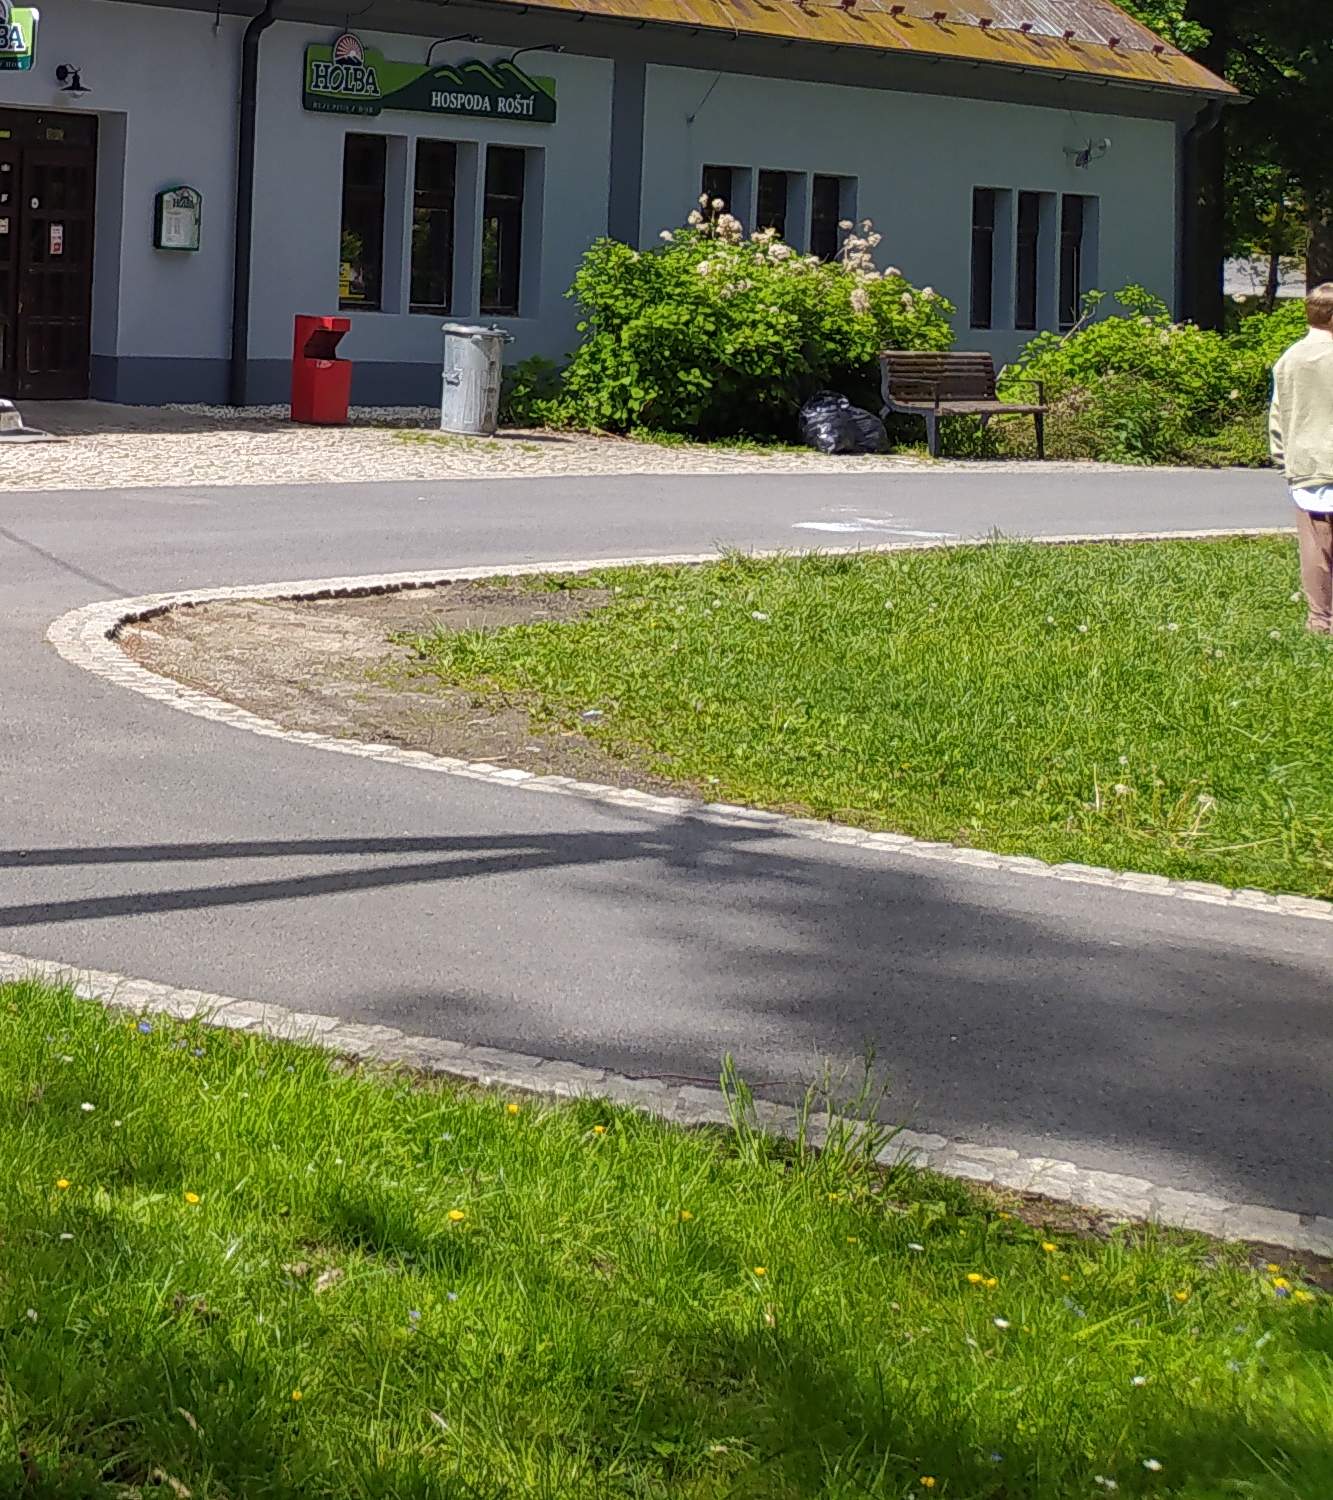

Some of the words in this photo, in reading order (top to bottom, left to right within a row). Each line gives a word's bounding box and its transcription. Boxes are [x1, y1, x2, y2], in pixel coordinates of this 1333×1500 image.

[312, 63, 381, 95] HOLBA
[431, 92, 492, 112] HOSPODA
[497, 94, 534, 115] ROŠTÍ
